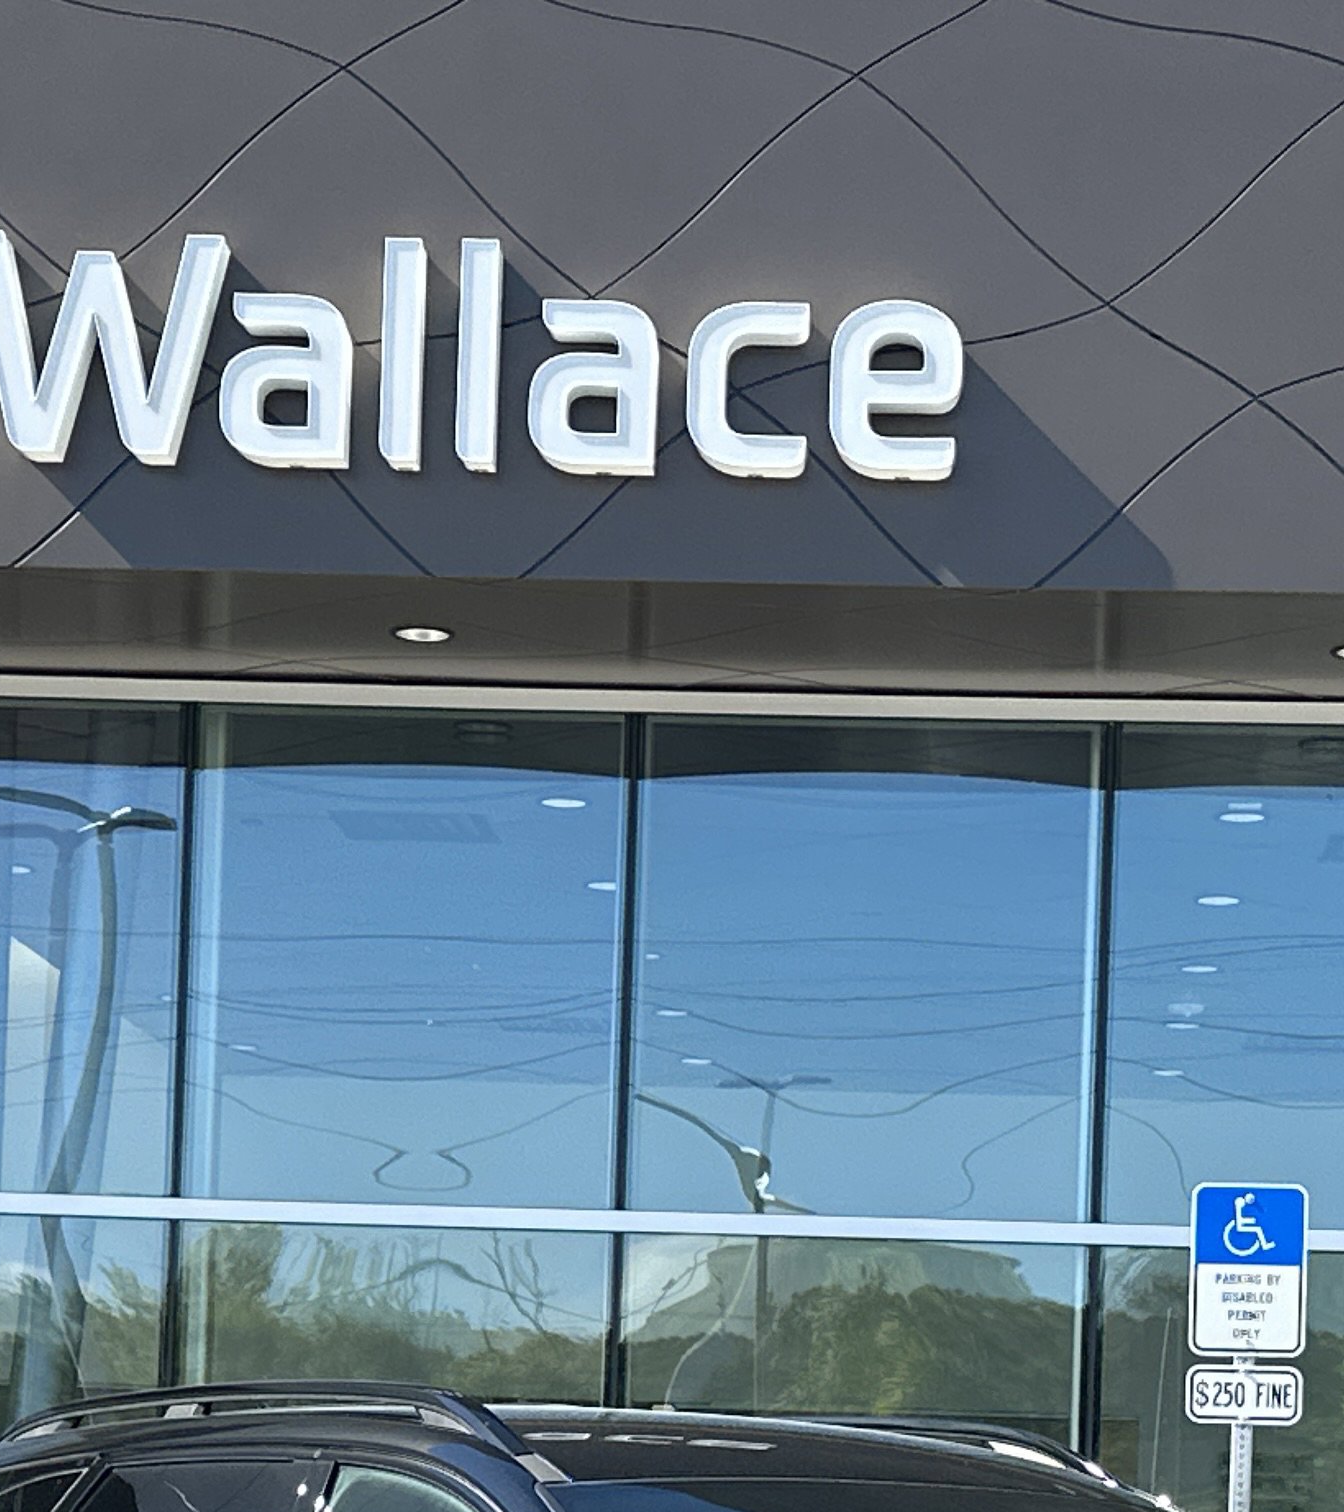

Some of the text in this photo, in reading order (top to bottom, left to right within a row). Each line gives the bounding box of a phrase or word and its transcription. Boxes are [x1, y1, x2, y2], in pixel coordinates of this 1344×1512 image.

[1214, 1272, 1281, 1286] PARKING BY
[1221, 1292, 1273, 1304] DISABLED
[1194, 1378, 1293, 1409] $250 FINE
